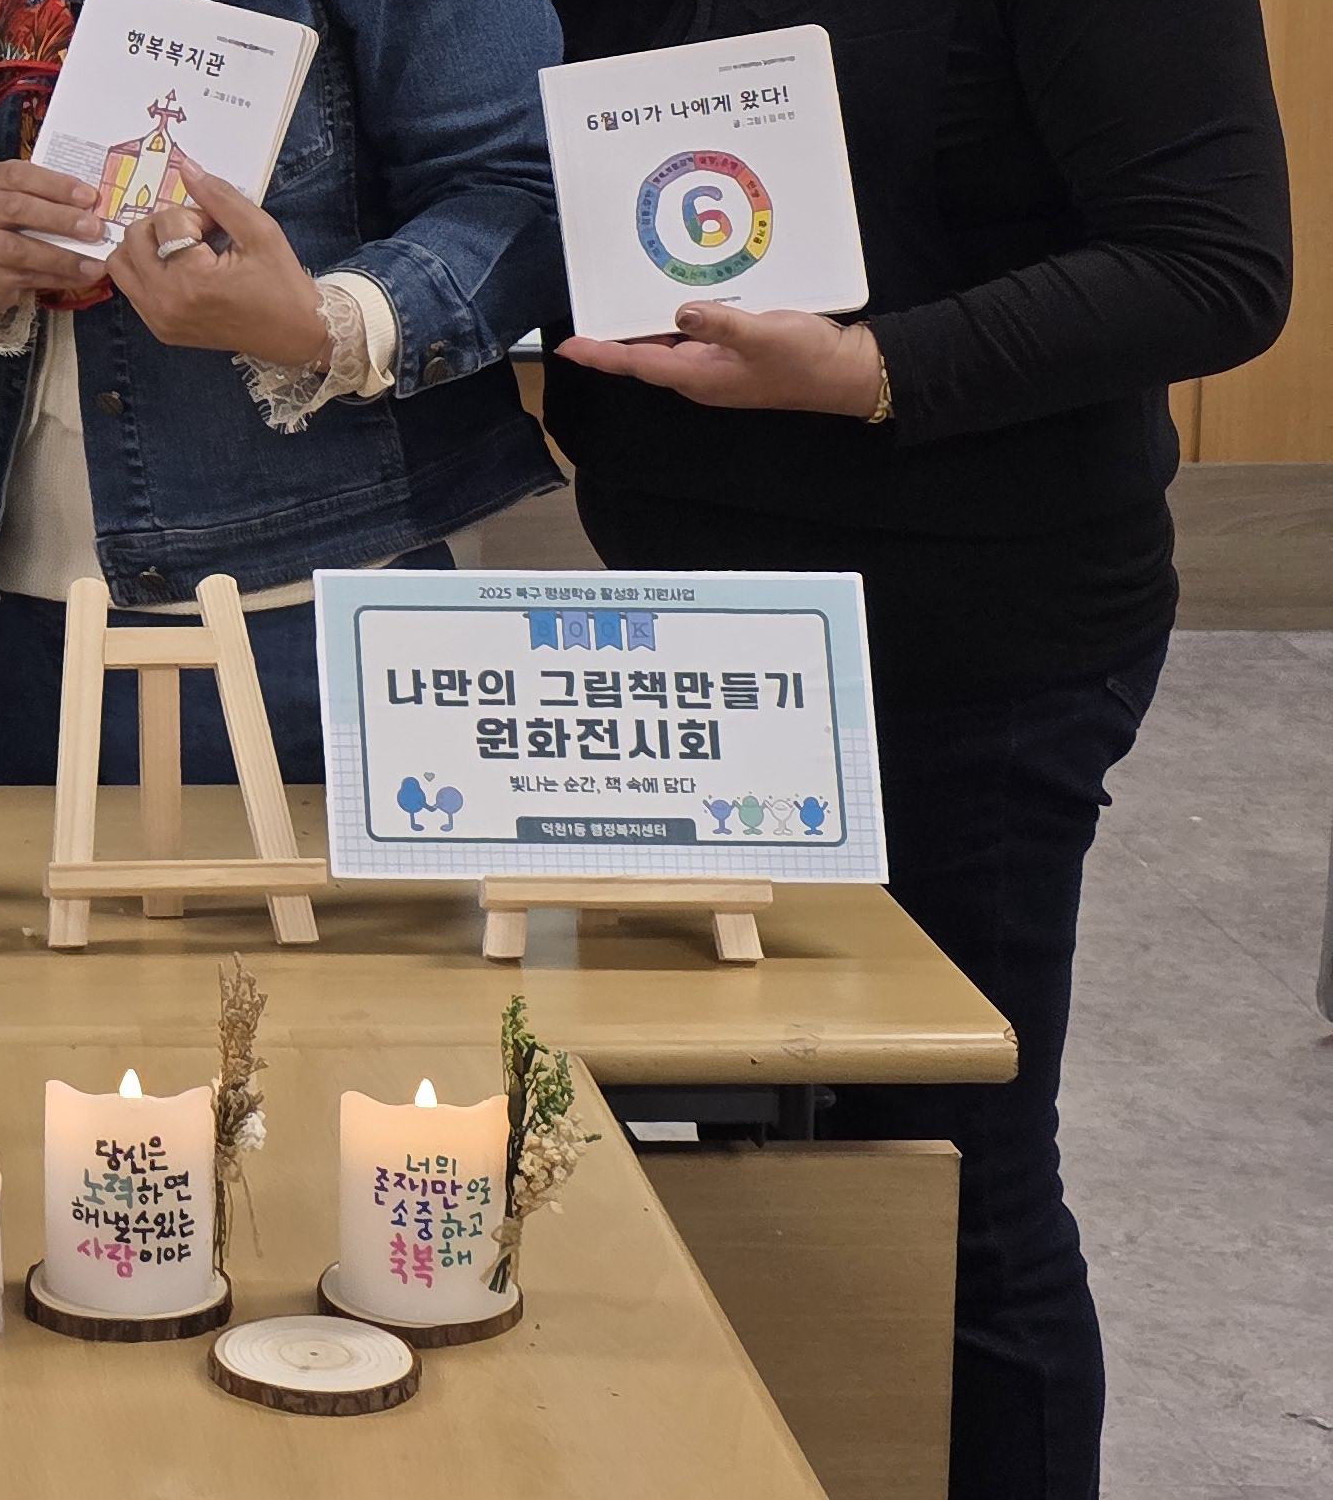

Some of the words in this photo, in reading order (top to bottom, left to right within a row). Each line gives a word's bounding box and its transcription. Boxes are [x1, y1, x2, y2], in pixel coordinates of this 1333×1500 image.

[127, 30, 226, 78] 행복복지관
[586, 104, 663, 132] 6월이가
[670, 94, 732, 119] 나에게
[739, 85, 790, 110] 왔다!
[478, 586, 512, 600] 2025
[544, 587, 597, 600] 평생학습
[643, 587, 696, 602] 지원사업
[387, 669, 517, 707] 나만의
[539, 669, 805, 709] 그림책만들기
[476, 717, 721, 761] 원화전시회
[509, 775, 559, 793] 빛나는
[563, 775, 601, 794] 순간,
[604, 775, 621, 793] 책
[626, 776, 659, 794] 속에
[663, 777, 697, 794] 담다
[96, 1136, 169, 1174] 당신은
[406, 1154, 456, 1176] 너의
[391, 1199, 482, 1241] 소중하고
[77, 1237, 191, 1278] 사람이야
[390, 1232, 472, 1288] 축복해
